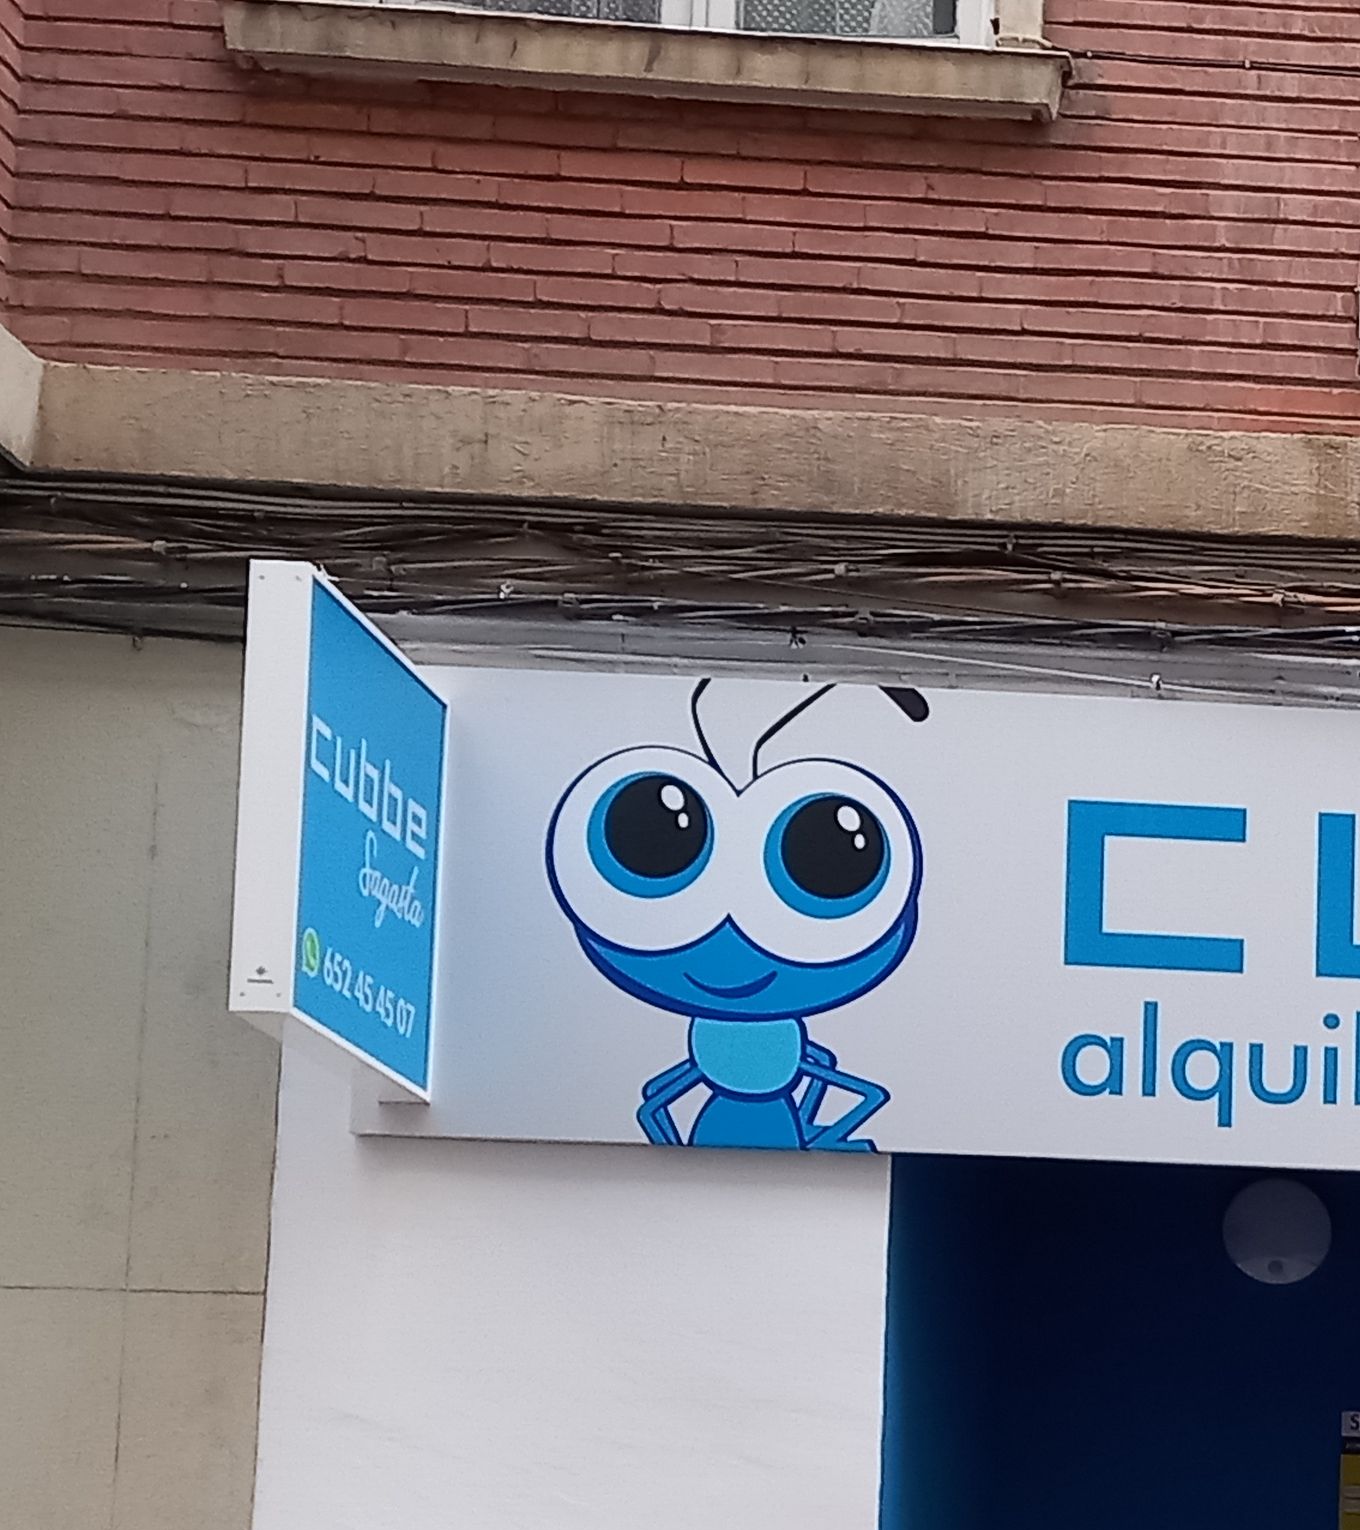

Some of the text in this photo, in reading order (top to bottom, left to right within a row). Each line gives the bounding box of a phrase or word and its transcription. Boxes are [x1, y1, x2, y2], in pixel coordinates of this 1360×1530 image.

[310, 714, 427, 859] cubbe
[358, 830, 424, 928] Sagasta
[323, 947, 416, 1039] 652 45 45 07
